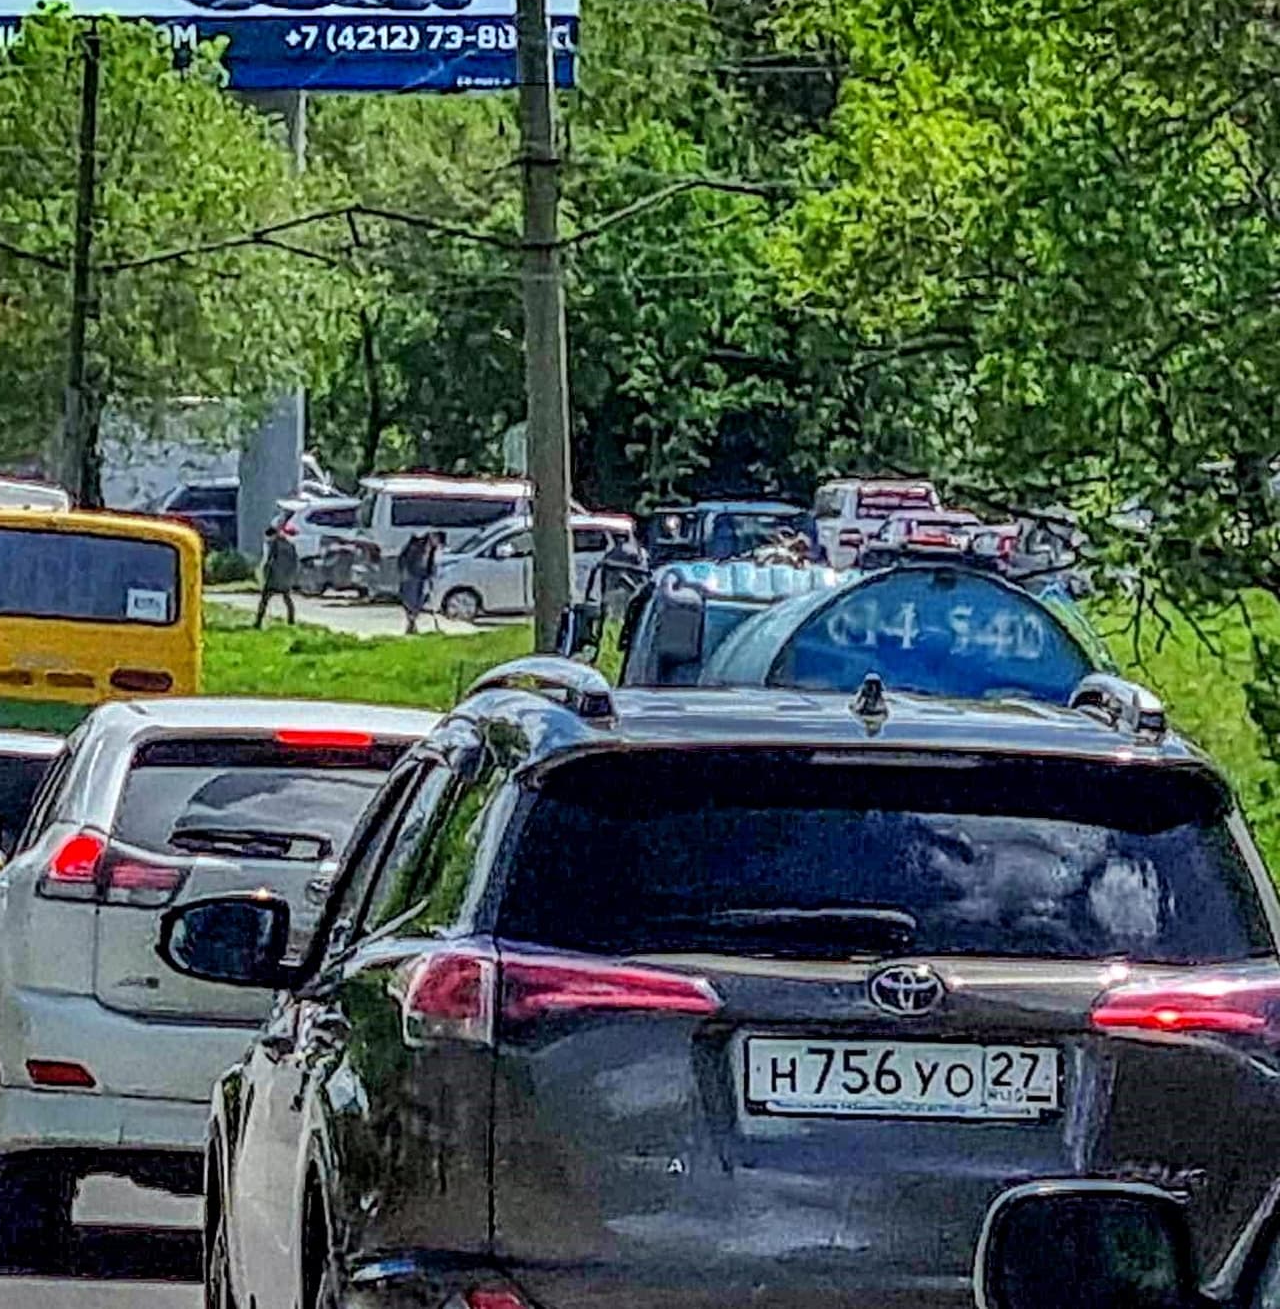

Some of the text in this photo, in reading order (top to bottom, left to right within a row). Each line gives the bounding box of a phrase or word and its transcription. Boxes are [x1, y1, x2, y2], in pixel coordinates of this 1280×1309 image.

[286, 24, 319, 50] +7
[326, 23, 420, 52] (4212)
[991, 1051, 1040, 1089] 27
